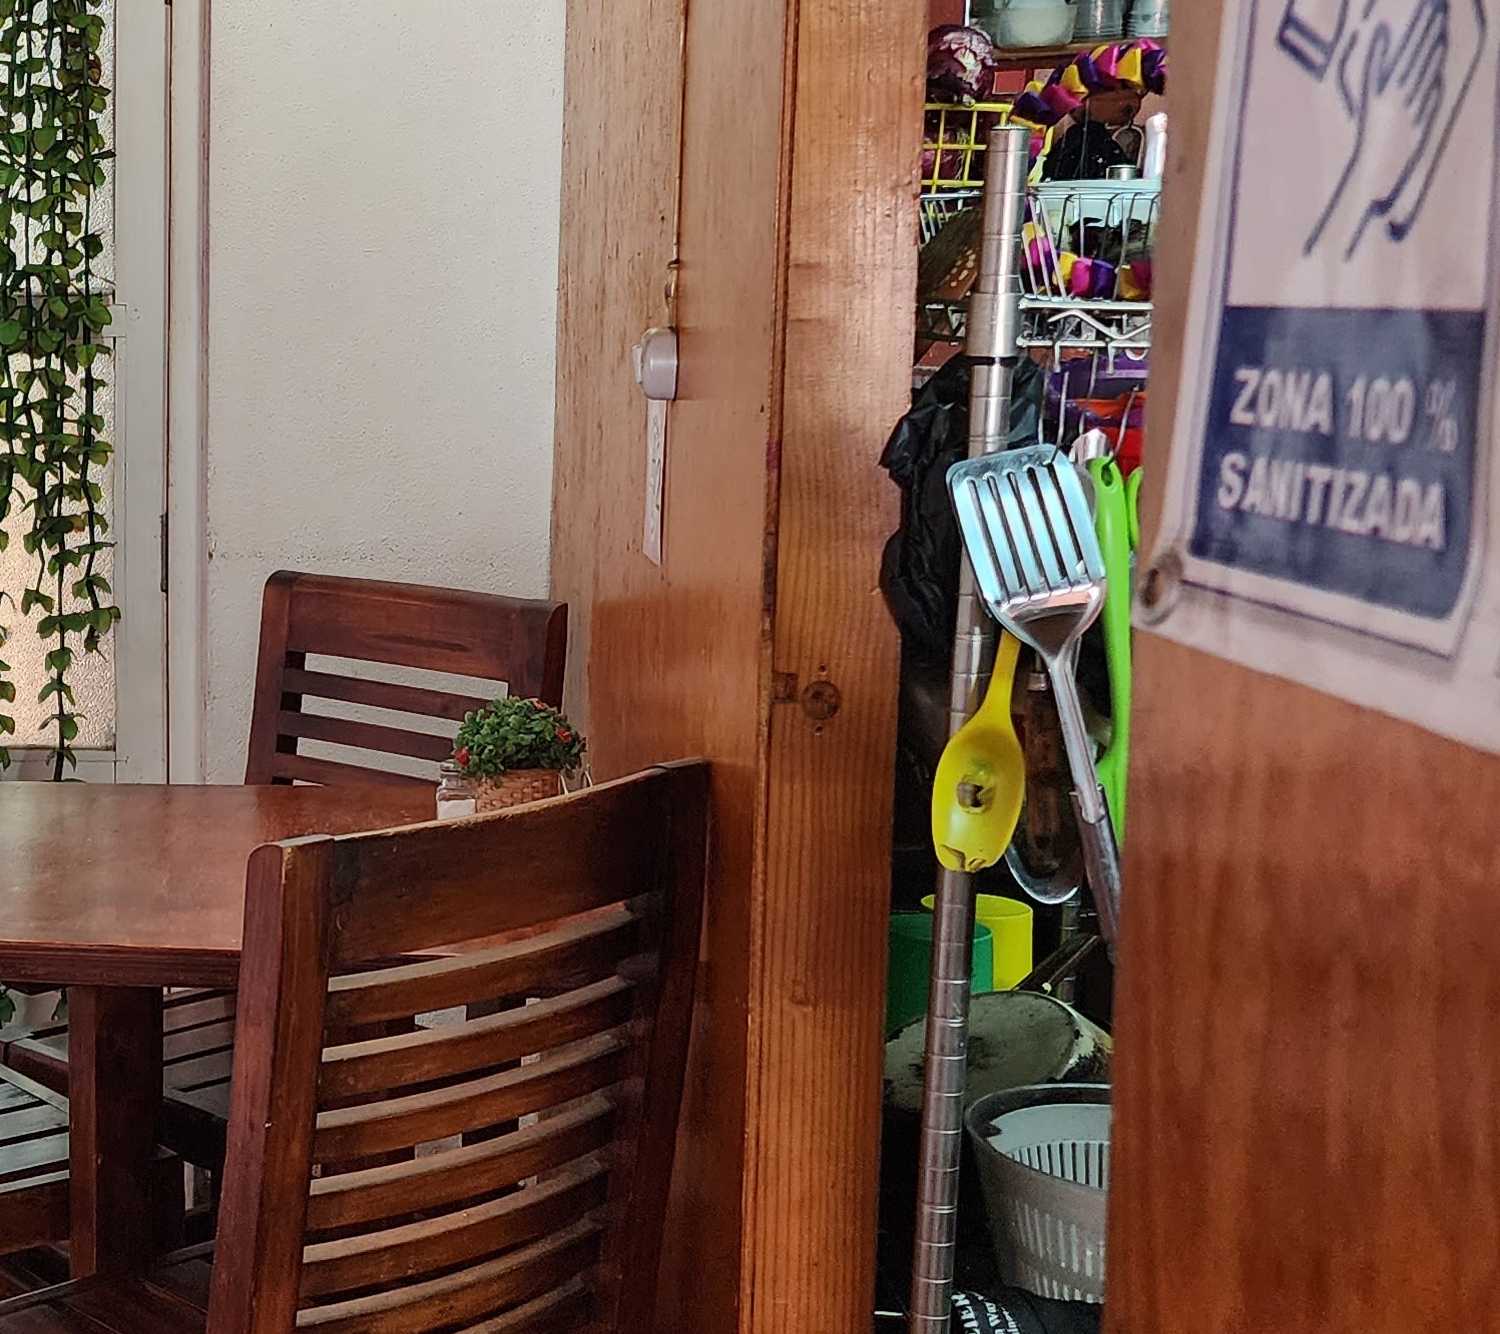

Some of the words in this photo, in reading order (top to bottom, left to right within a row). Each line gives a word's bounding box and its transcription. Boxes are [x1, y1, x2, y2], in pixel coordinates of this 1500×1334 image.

[1229, 368, 1331, 433] ZONA
[1347, 375, 1416, 445] 100
[1217, 453, 1445, 550] SANITIZADA
